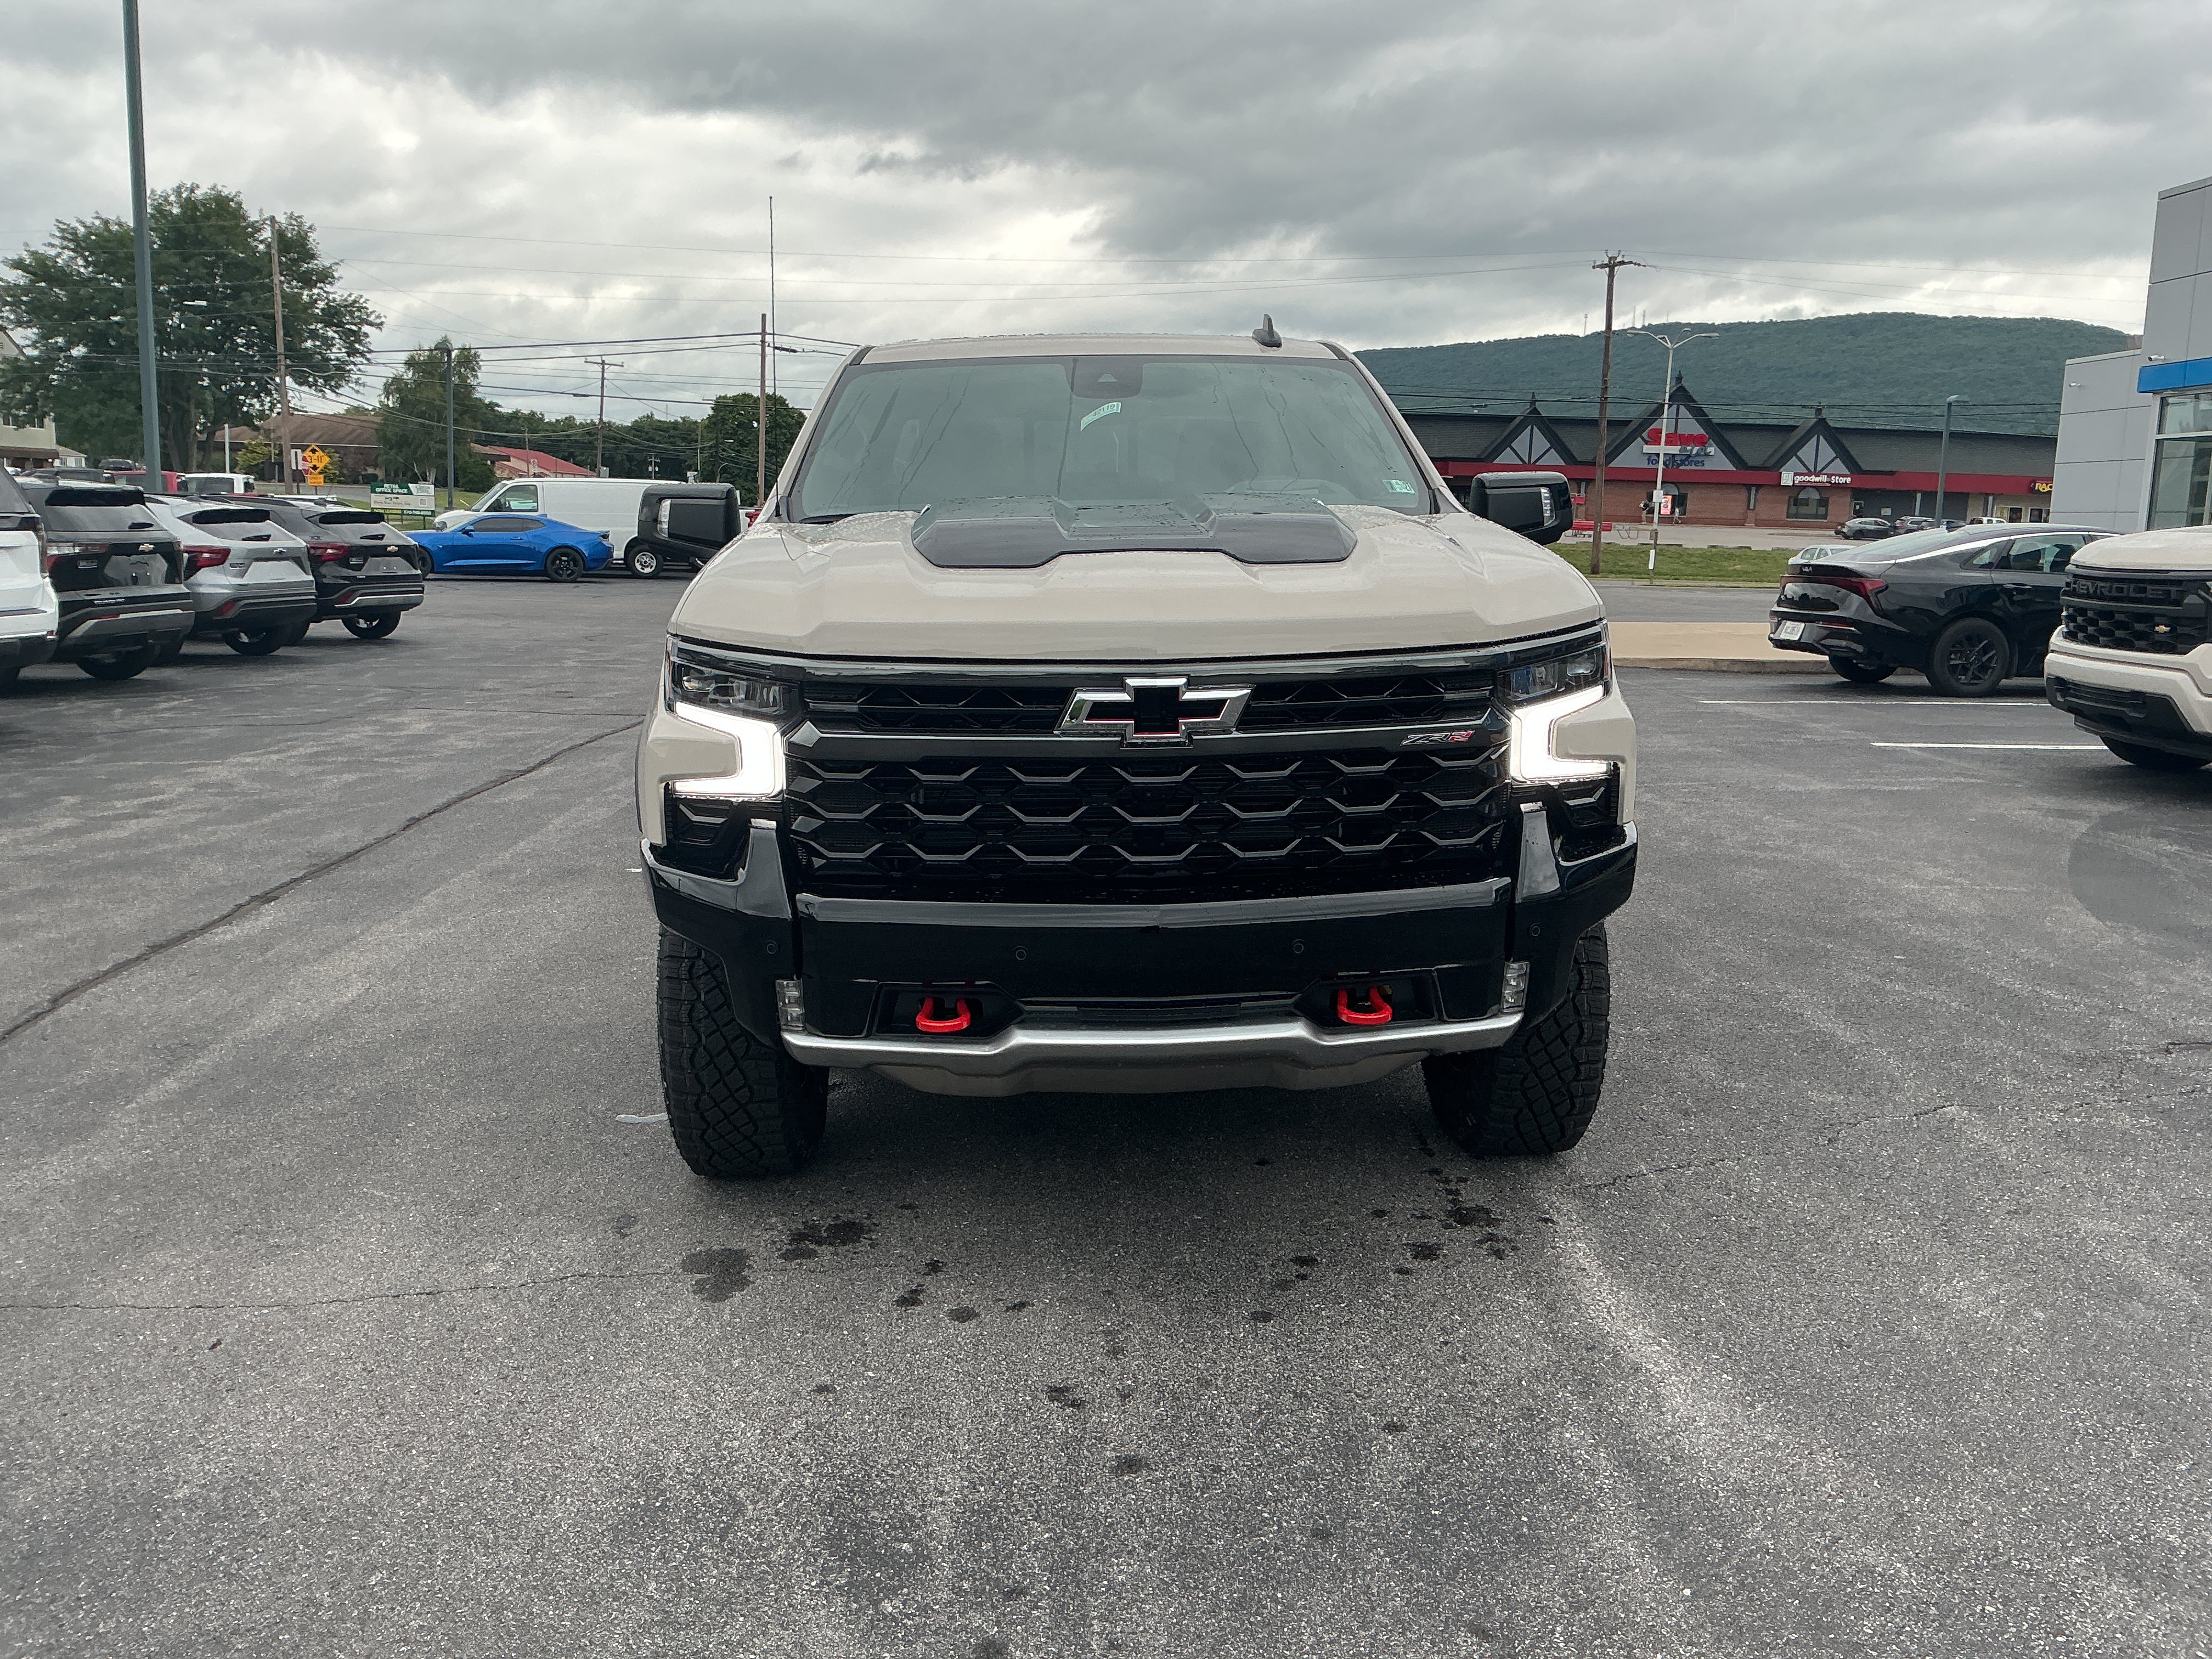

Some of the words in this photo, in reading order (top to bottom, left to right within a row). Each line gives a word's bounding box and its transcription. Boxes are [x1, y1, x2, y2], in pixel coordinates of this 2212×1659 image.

[1647, 428, 1709, 447] Save
[1647, 455, 1671, 466] fod
[1794, 475, 1827, 483] goodwill
[1831, 475, 1852, 483] Store
[2064, 578, 2186, 600] CHEVROLET
[1400, 730, 1476, 746] ZR2
